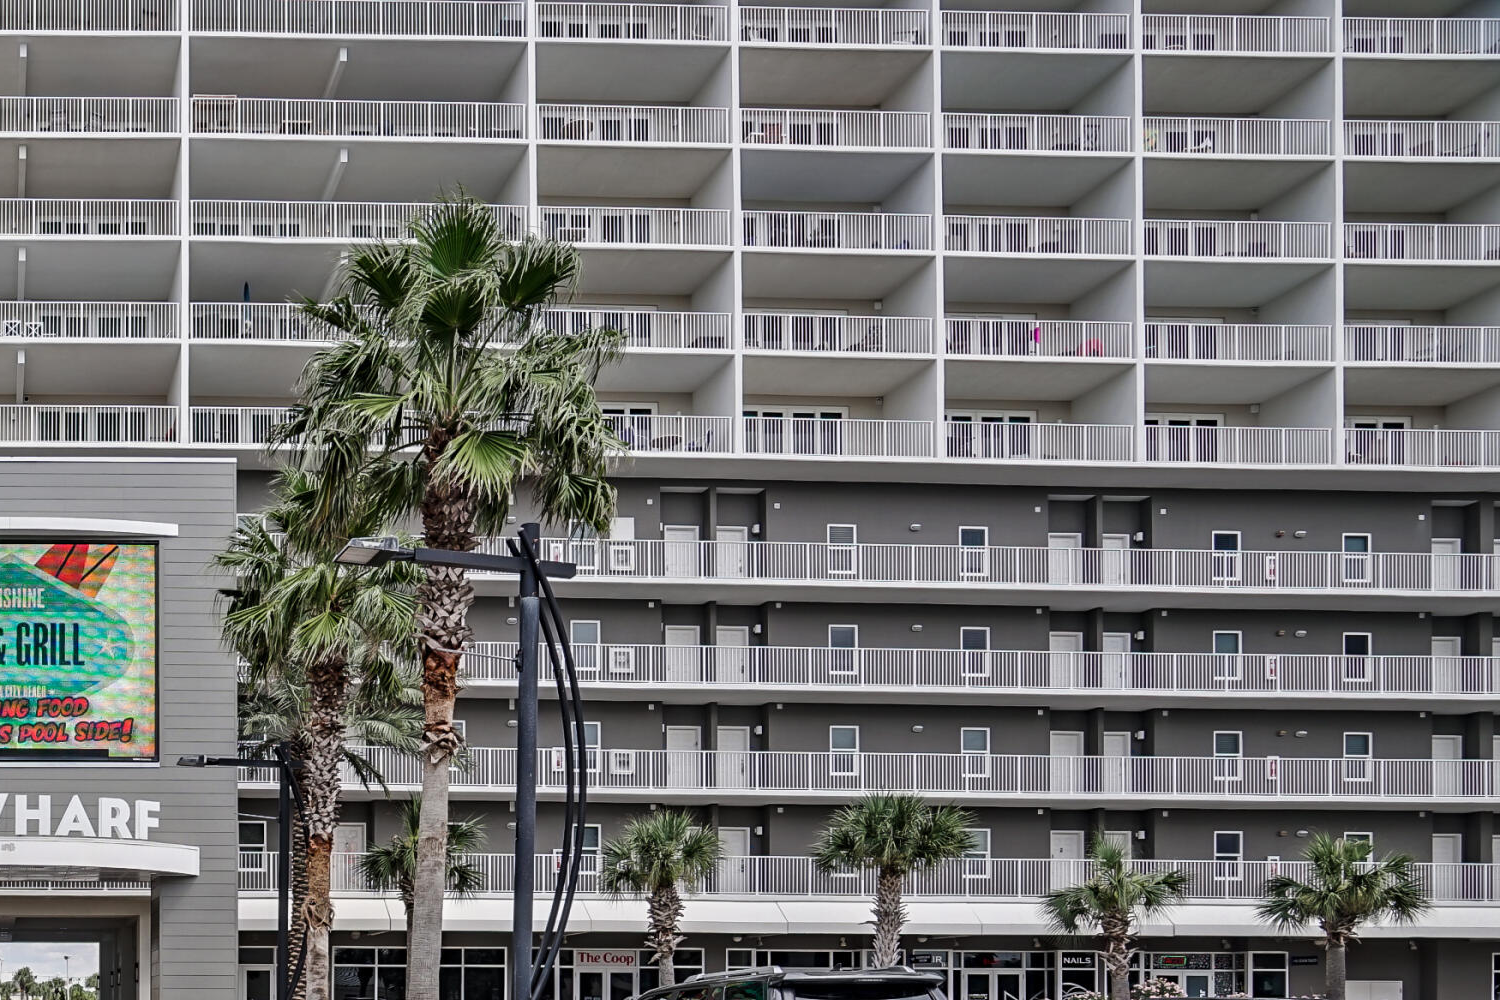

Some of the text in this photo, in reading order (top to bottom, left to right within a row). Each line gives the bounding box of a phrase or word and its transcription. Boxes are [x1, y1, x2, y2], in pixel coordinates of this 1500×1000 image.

[15, 621, 85, 667] GRILL
[4, 685, 21, 698] CITY
[22, 685, 46, 698] BEACH
[36, 696, 90, 719] FOOD
[18, 723, 68, 744] POOL
[74, 717, 135, 744] SIDE!
[578, 952, 634, 966] The Coop
